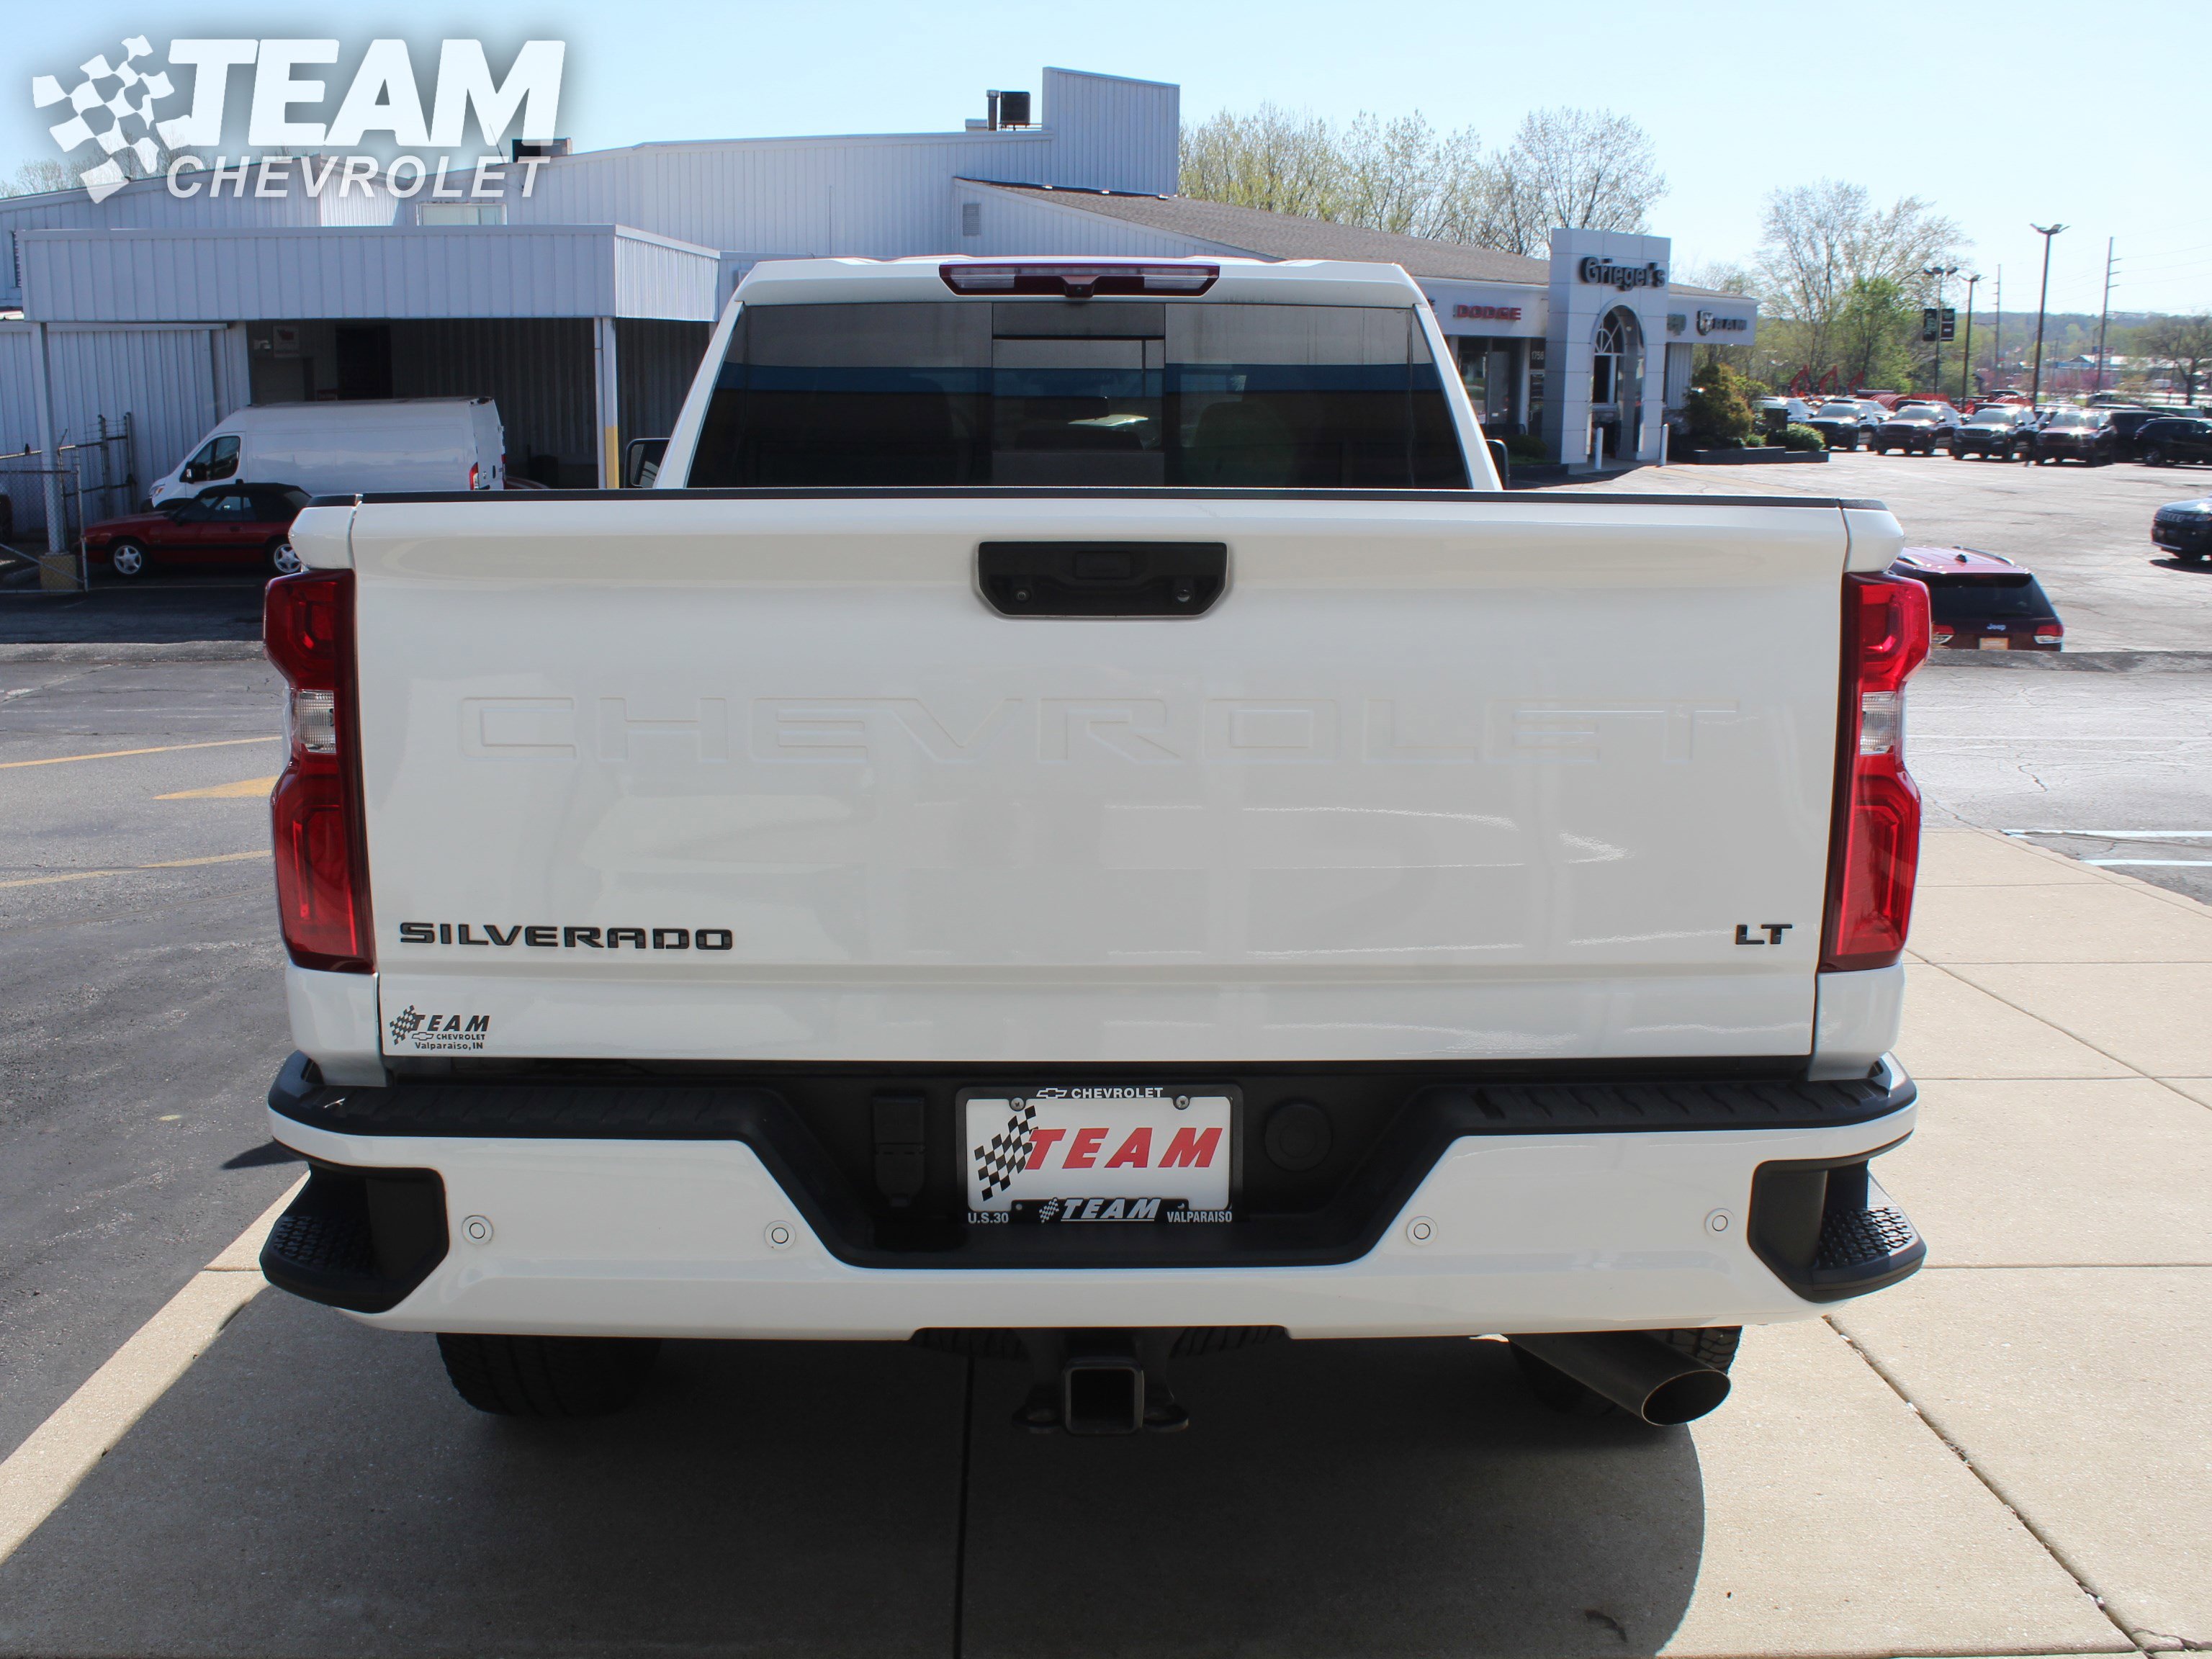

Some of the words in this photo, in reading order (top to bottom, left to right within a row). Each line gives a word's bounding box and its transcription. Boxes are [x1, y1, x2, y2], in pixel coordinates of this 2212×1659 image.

[1581, 256, 1665, 290] Grieger's
[1453, 305, 1522, 321] DODGE
[461, 697, 1740, 763] CHEVROLET
[400, 922, 733, 950] SILVERADO
[1735, 924, 1793, 945] LT
[411, 1014, 490, 1032] TEAM
[1071, 1087, 1164, 1099] CHEVROLET
[1024, 1127, 1223, 1170] TEAM
[1061, 1198, 1162, 1221] TEAM
[1166, 1211, 1233, 1223] VALPARAISO
